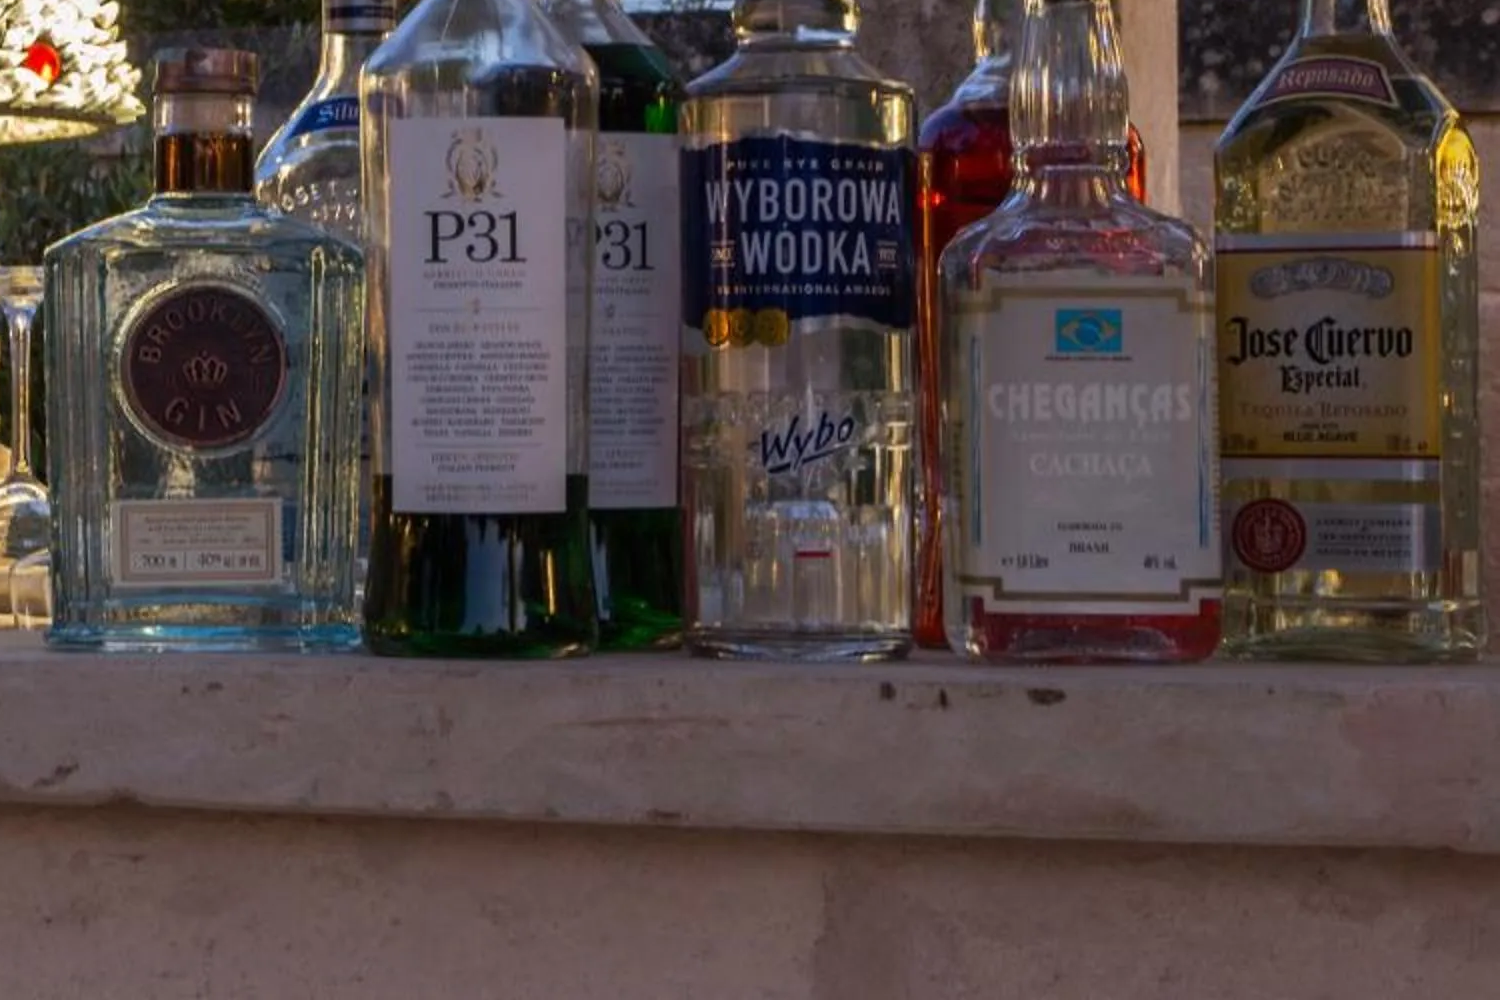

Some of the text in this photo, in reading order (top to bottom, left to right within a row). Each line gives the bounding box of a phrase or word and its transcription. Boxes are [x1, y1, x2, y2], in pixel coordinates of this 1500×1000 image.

[1276, 66, 1375, 90] Reposado
[705, 178, 901, 224] WYBOROWA
[423, 210, 528, 264] P31
[740, 221, 872, 275] WÓDKA
[137, 297, 275, 364] BROOKLYN
[1223, 315, 1414, 367] Jose Cuervo
[1279, 365, 1362, 395] Especial
[164, 396, 242, 433] GIN
[987, 382, 1193, 428] CHEGANÇAS
[760, 410, 855, 470] Wybo
[1029, 452, 1155, 485] CACHAÇA
